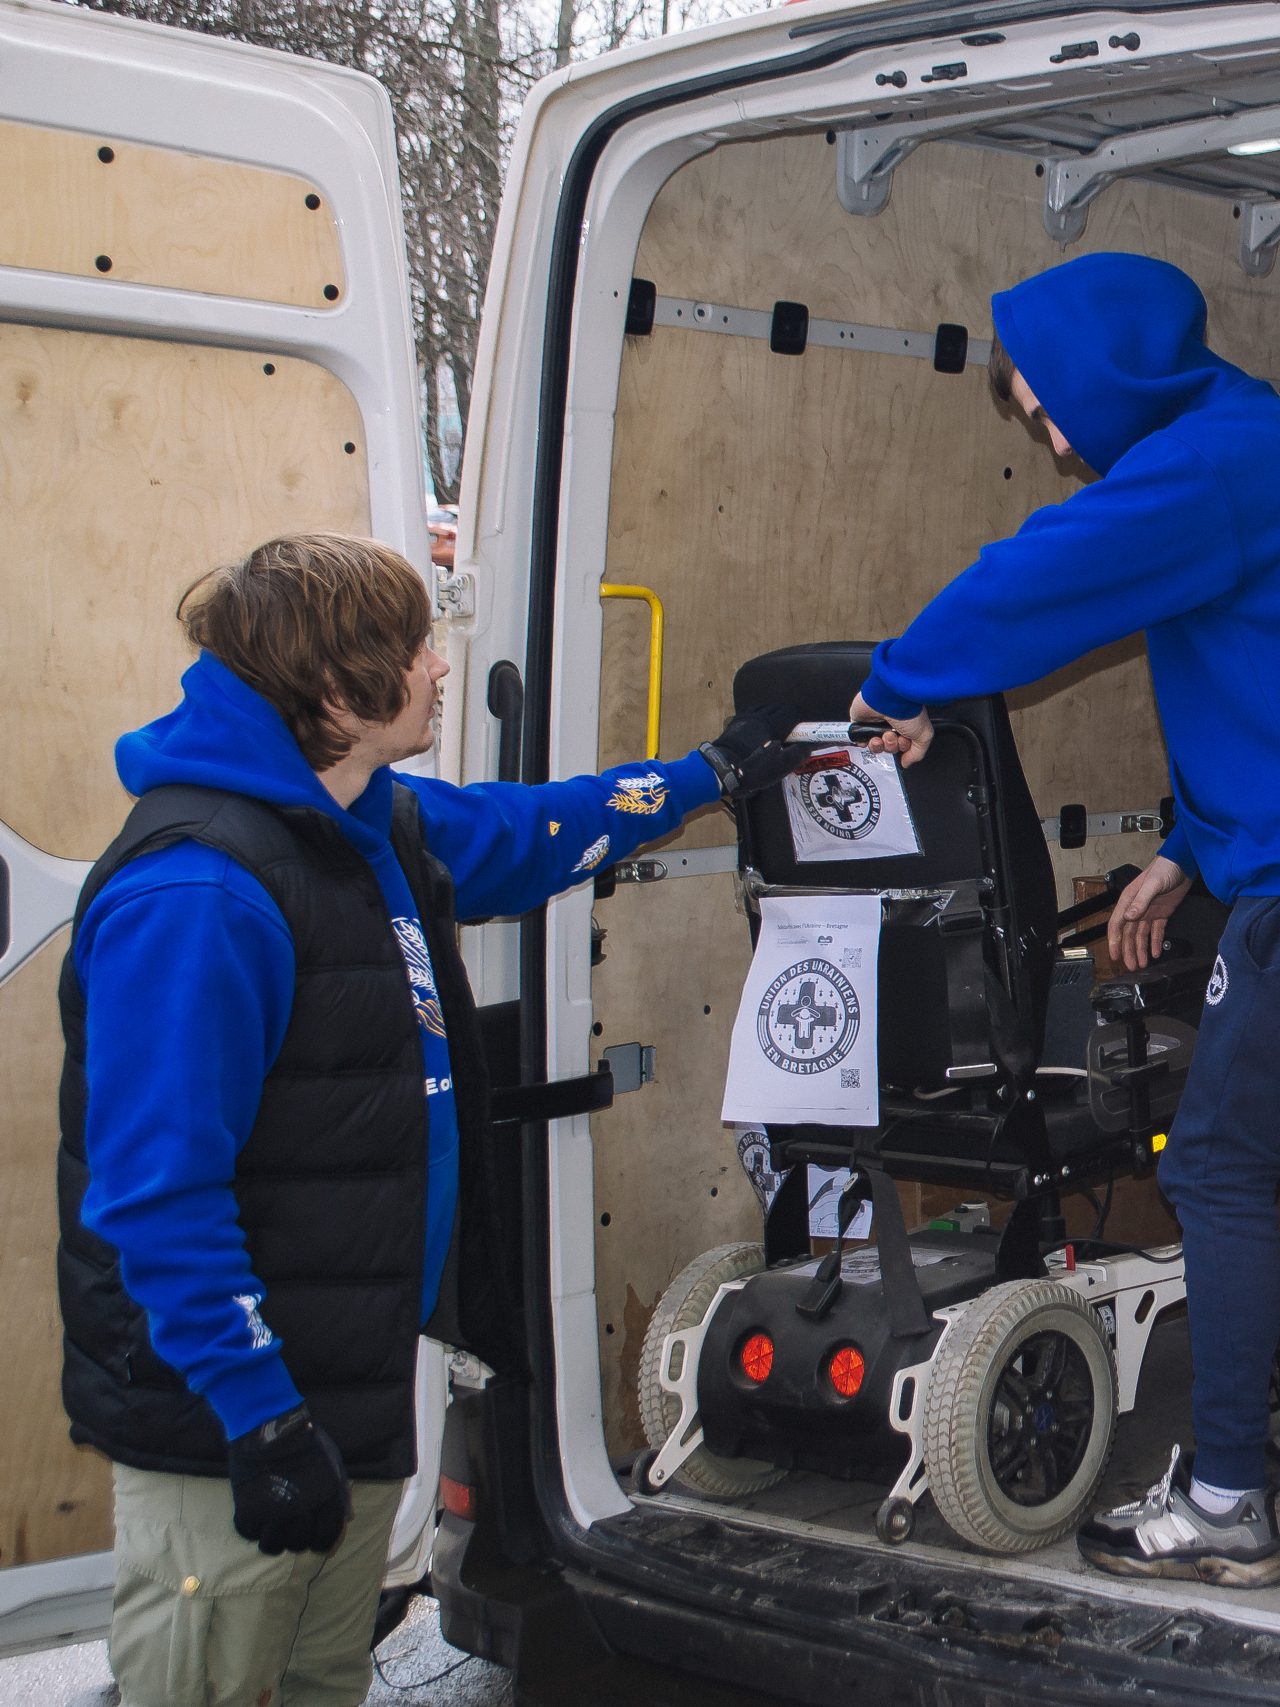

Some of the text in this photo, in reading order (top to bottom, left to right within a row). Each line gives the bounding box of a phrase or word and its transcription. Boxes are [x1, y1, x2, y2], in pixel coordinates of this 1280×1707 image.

[849, 764, 880, 822] EN BRETAGNE
[808, 806, 822, 823] DES
[823, 821, 852, 839] UNION
[761, 960, 858, 1014] UNION DES UKRAINIENS
[766, 1046, 843, 1073] EN BRETAGNE
